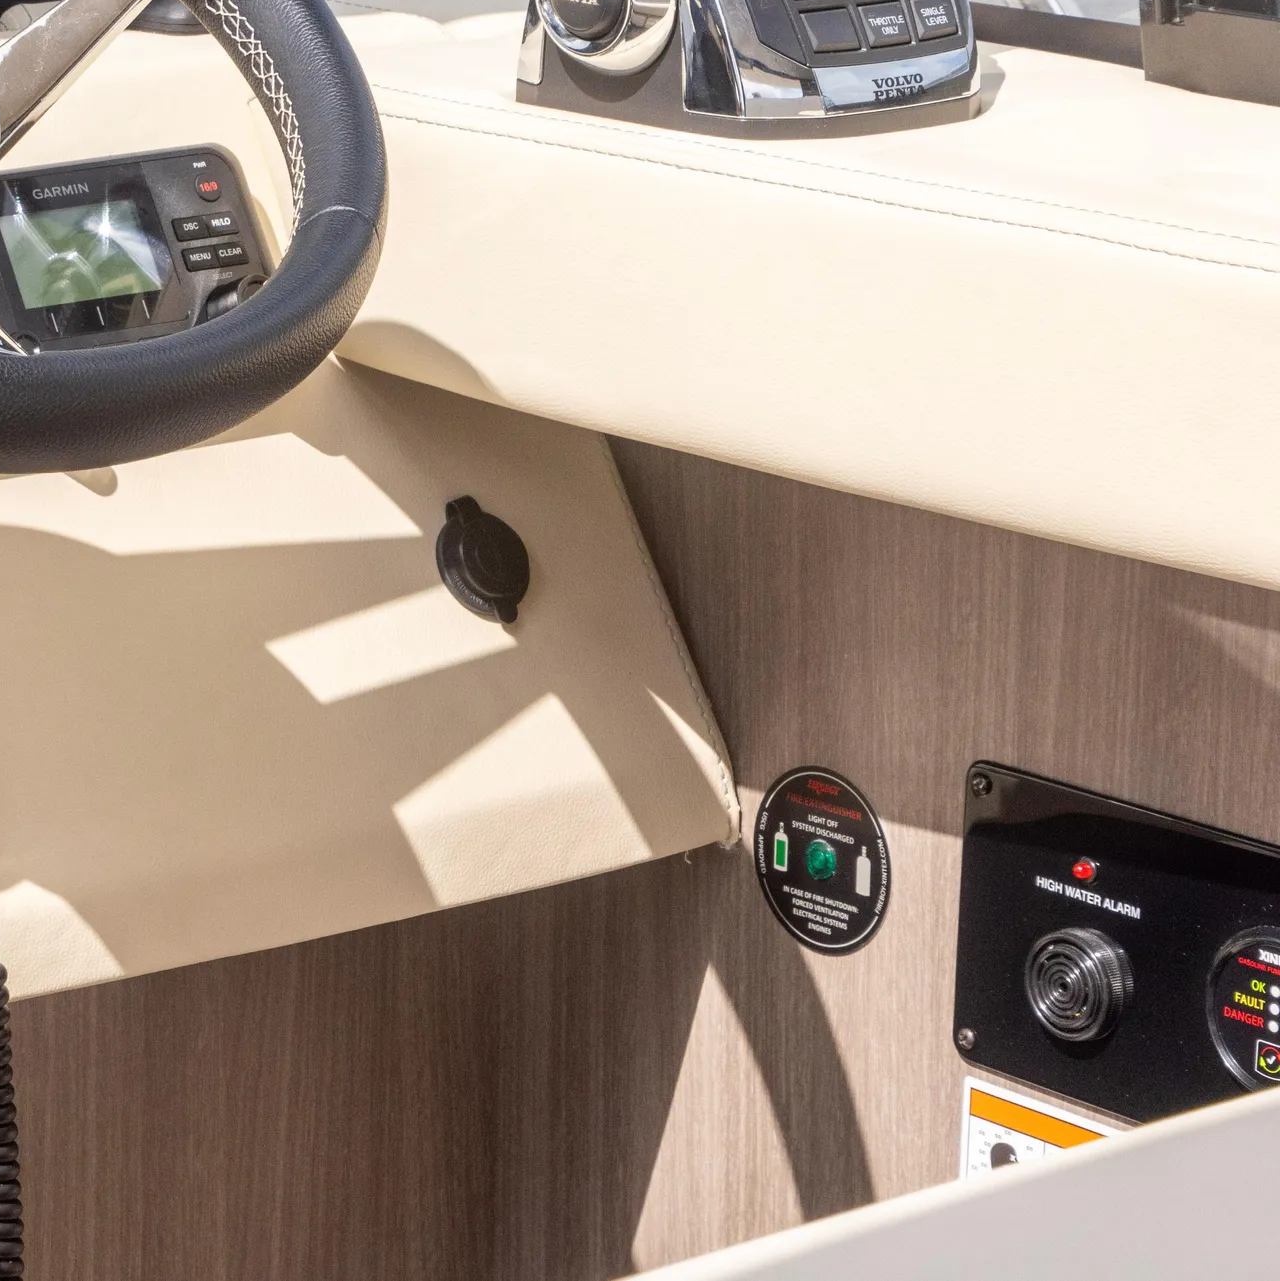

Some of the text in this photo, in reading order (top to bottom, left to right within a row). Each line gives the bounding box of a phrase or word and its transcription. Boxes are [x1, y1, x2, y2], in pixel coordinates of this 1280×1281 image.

[920, 6, 945, 17] SINGLE
[868, 15, 905, 26] THROTTLE
[925, 16, 949, 26] LEVER
[881, 25, 899, 35] ONLY
[871, 73, 923, 89] VOLVO
[873, 84, 927, 102] PENTA
[192, 160, 207, 169] PWR
[32, 182, 90, 200] GARMIN
[199, 181, 218, 192] 16/9
[183, 222, 199, 231] DSC
[211, 217, 232, 228] HI/LO
[189, 252, 212, 262] MENU
[218, 247, 243, 257] CLEAR
[804, 797, 862, 822] EXTINGUISHER
[807, 813, 840, 829] LIGHT OFF
[792, 821, 855, 845] SYSTEM DISCHARGED
[758, 811, 769, 874] USCG APPROVED
[783, 885, 860, 913] IN CASE OF FIRE SHUTDOWN:
[1036, 875, 1141, 920] HIGH WATER ALARM
[792, 898, 849, 921] FORCED VENTILATION
[793, 908, 848, 931] ELECTRICAL SYSTEMS
[808, 922, 832, 936] ENGINES
[1237, 957, 1267, 972] GASOLINE
[1251, 979, 1267, 994] OK
[1234, 991, 1266, 1010] FAULT
[1223, 1005, 1265, 1028] DANGER
